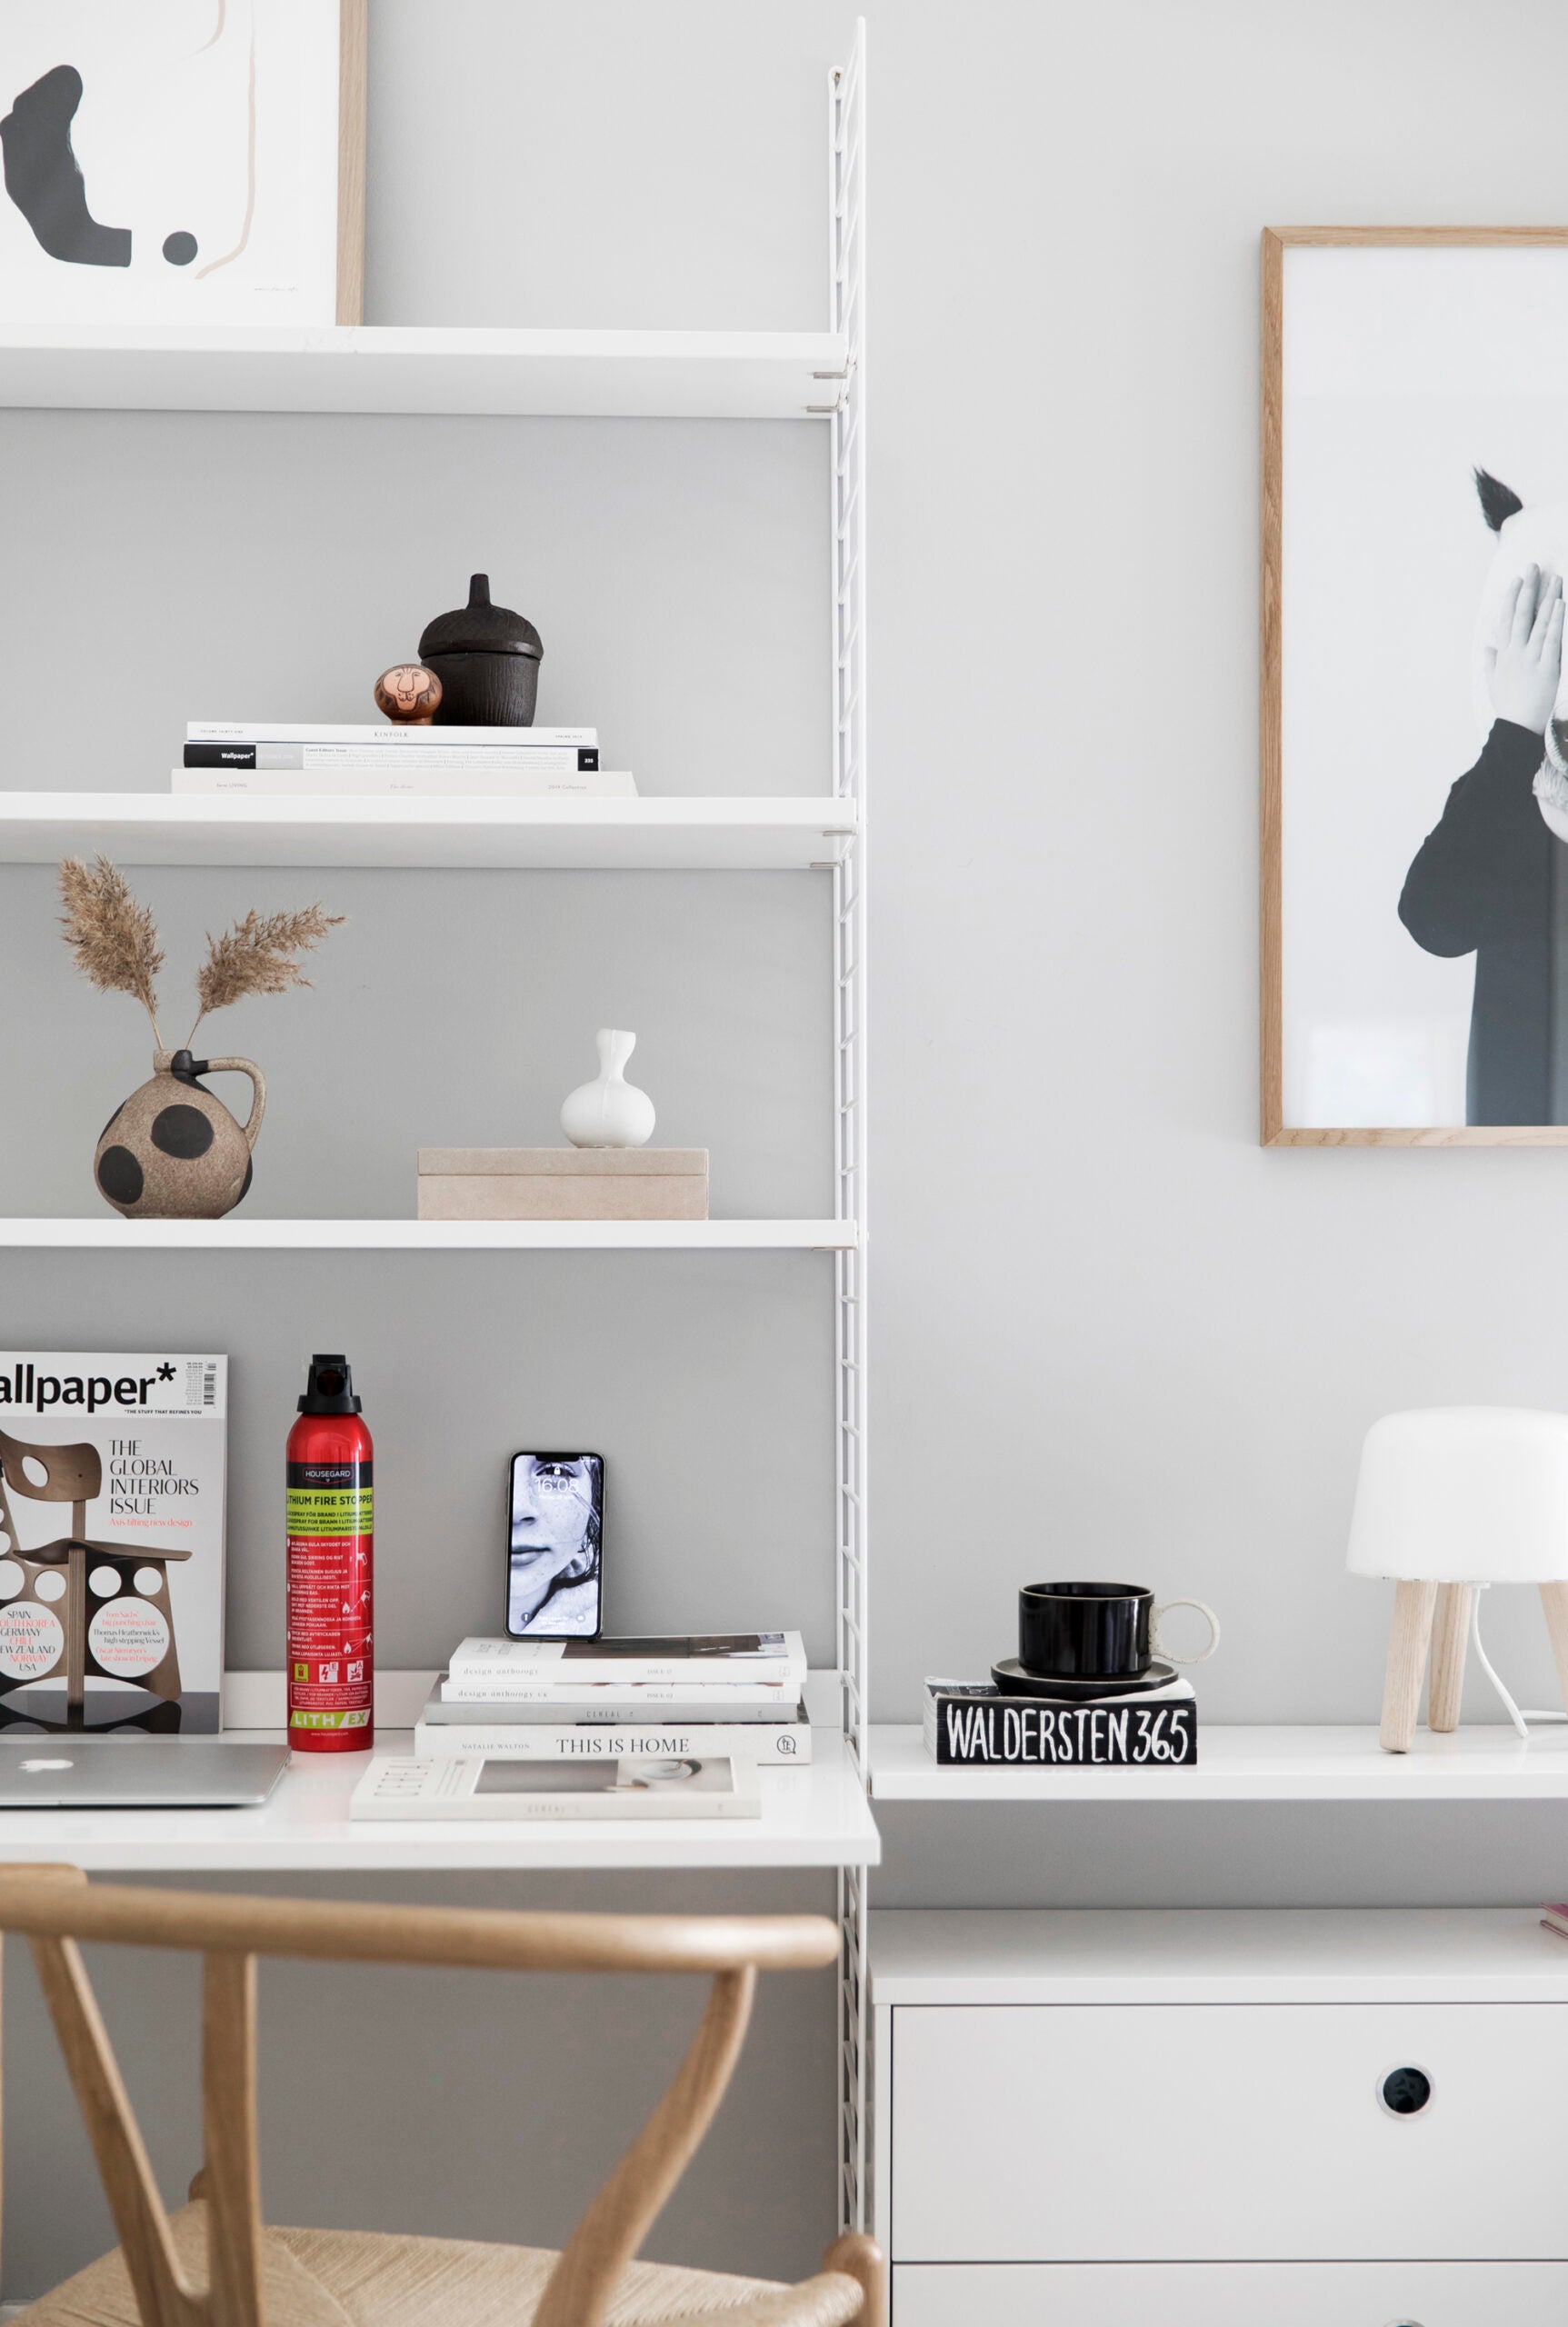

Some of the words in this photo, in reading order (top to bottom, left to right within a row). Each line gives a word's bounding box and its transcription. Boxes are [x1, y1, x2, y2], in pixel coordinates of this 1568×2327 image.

[108, 1440, 142, 1456] THE
[110, 1460, 178, 1476] GLOBAL
[305, 1470, 351, 1478] HOUSEGARD
[111, 1479, 199, 1495] INTERIORS
[534, 1478, 579, 1493] 16:08
[314, 1496, 337, 1506] FIRE
[110, 1498, 156, 1514] ISSUE
[167, 1517, 193, 1527] design
[7, 1611, 31, 1619] SPAIN
[26, 1620, 55, 1628] KOREA
[0, 1628, 41, 1637] GERMANY
[9, 1637, 33, 1645] CHILE
[15, 1645, 55, 1653] ZEALAND
[10, 1654, 48, 1663] NORWAY
[19, 1663, 36, 1672] USA
[464, 1667, 492, 1675] design
[496, 1667, 538, 1676] anthology
[458, 1690, 487, 1698] design
[490, 1690, 533, 1699] anthology
[295, 1713, 335, 1726] LITH
[347, 1712, 365, 1725] EX
[946, 1703, 1129, 1763] WALDERSTEN
[1133, 1710, 1188, 1763] 365
[555, 1738, 602, 1753] THIS
[607, 1738, 624, 1753] IS
[630, 1738, 690, 1753] HOME
